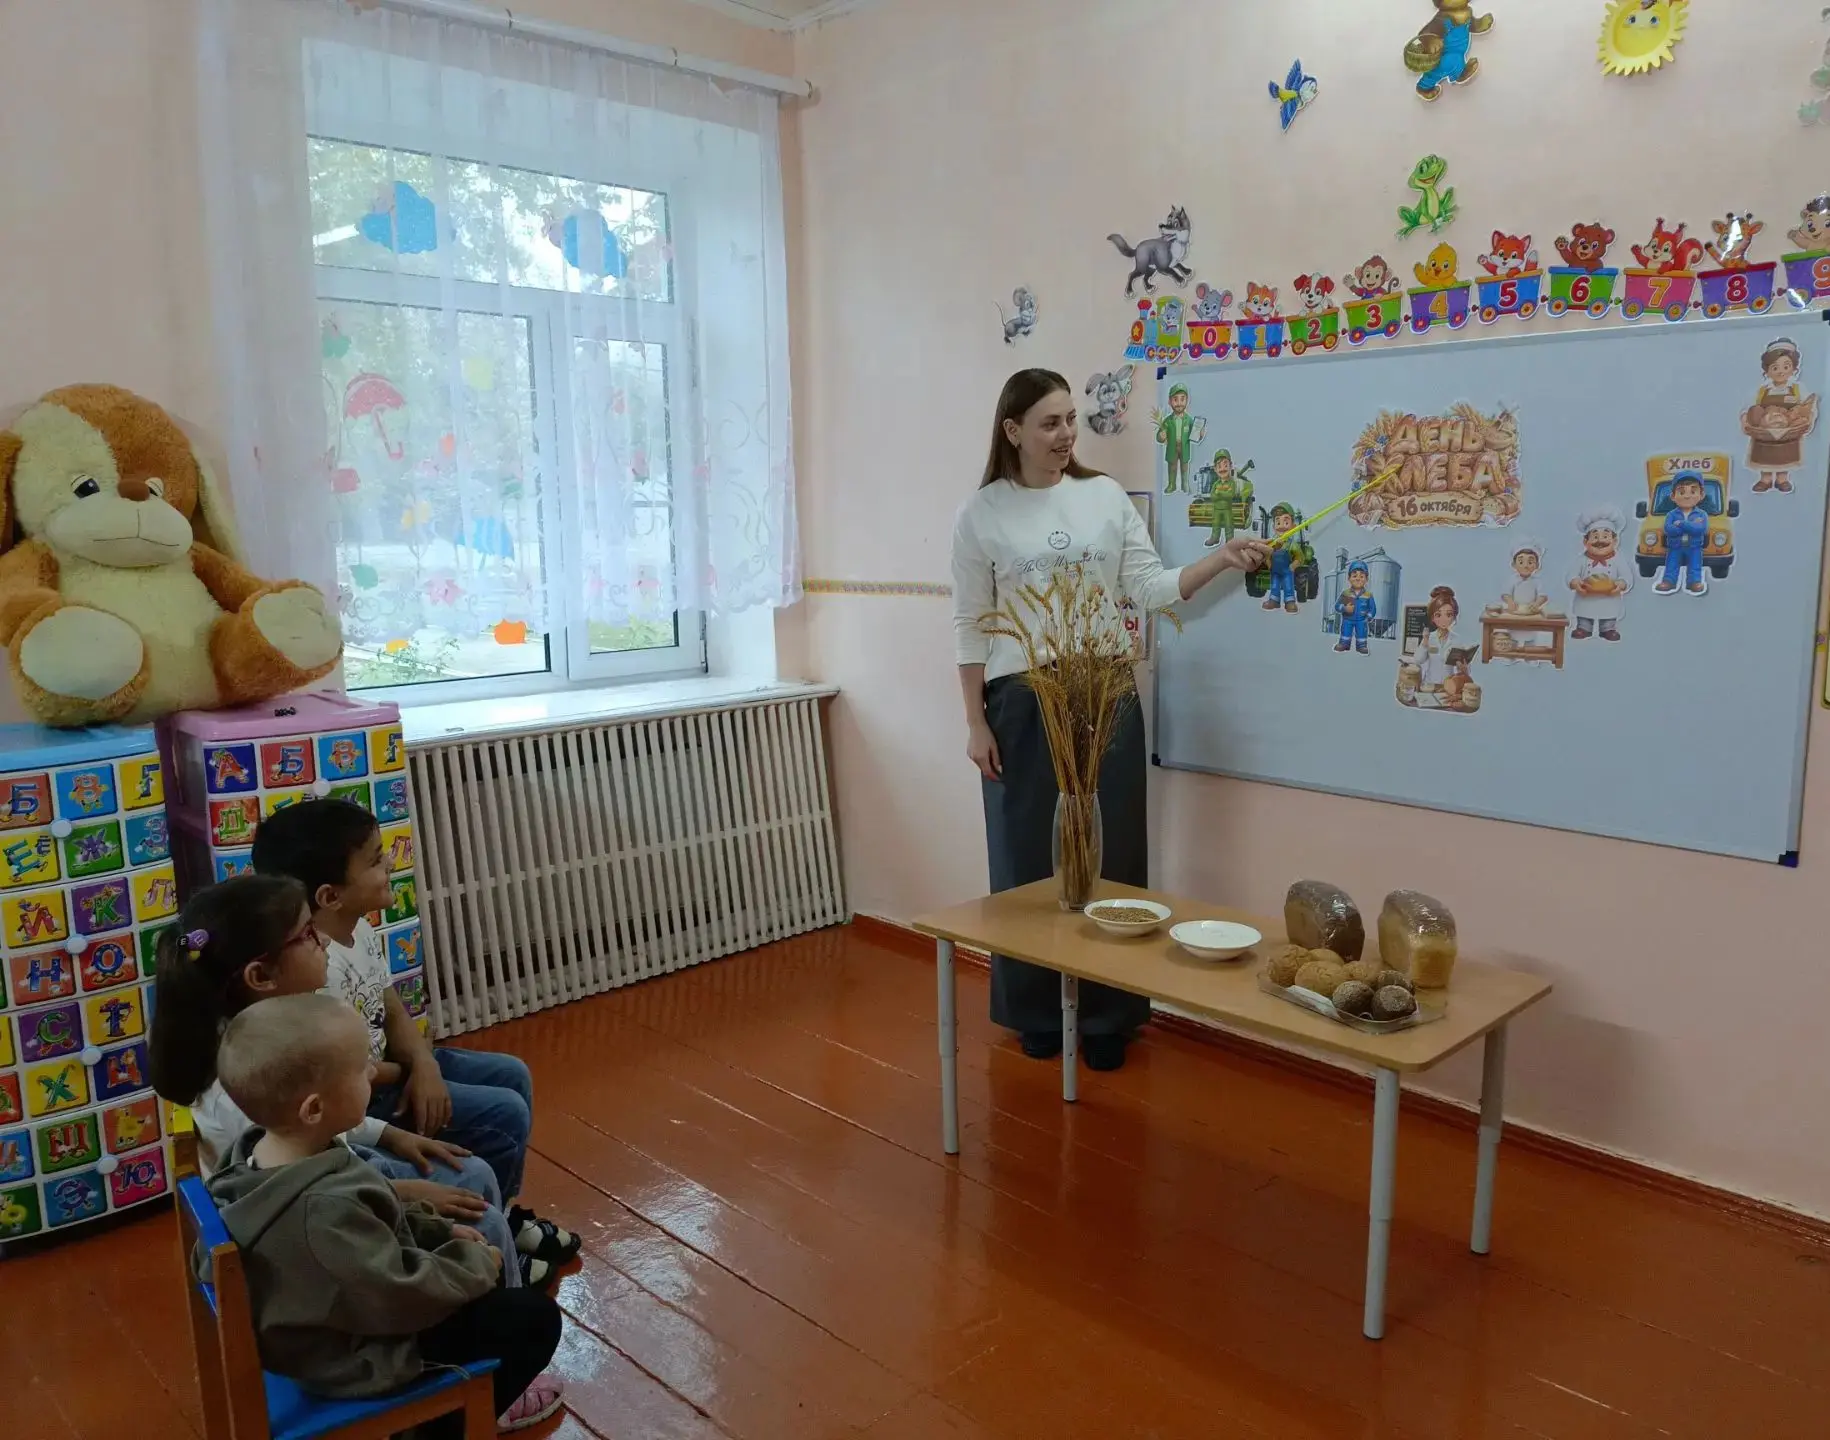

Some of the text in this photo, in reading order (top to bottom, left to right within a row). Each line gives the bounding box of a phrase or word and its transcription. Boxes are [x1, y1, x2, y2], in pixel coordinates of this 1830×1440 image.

[1203, 327, 1218, 347] 0
[1254, 325, 1266, 347] 1
[1307, 319, 1322, 341] 2
[1366, 304, 1383, 328] 3
[1429, 291, 1449, 318] 4
[1498, 281, 1519, 307] 5
[1569, 276, 1592, 303] 6
[1648, 278, 1672, 306] 7
[1725, 273, 1749, 302] 8
[1385, 414, 1484, 454] ДЕНЬ
[1668, 457, 1712, 471] Хлеб
[1396, 497, 1472, 516] 16 октября
[213, 749, 247, 788] А
[281, 745, 304, 775] Б
[11, 783, 39, 815] Б
[93, 893, 121, 927] К
[28, 943, 124, 991] Н О
[37, 1011, 71, 1044] С
[38, 1064, 78, 1109] Х
